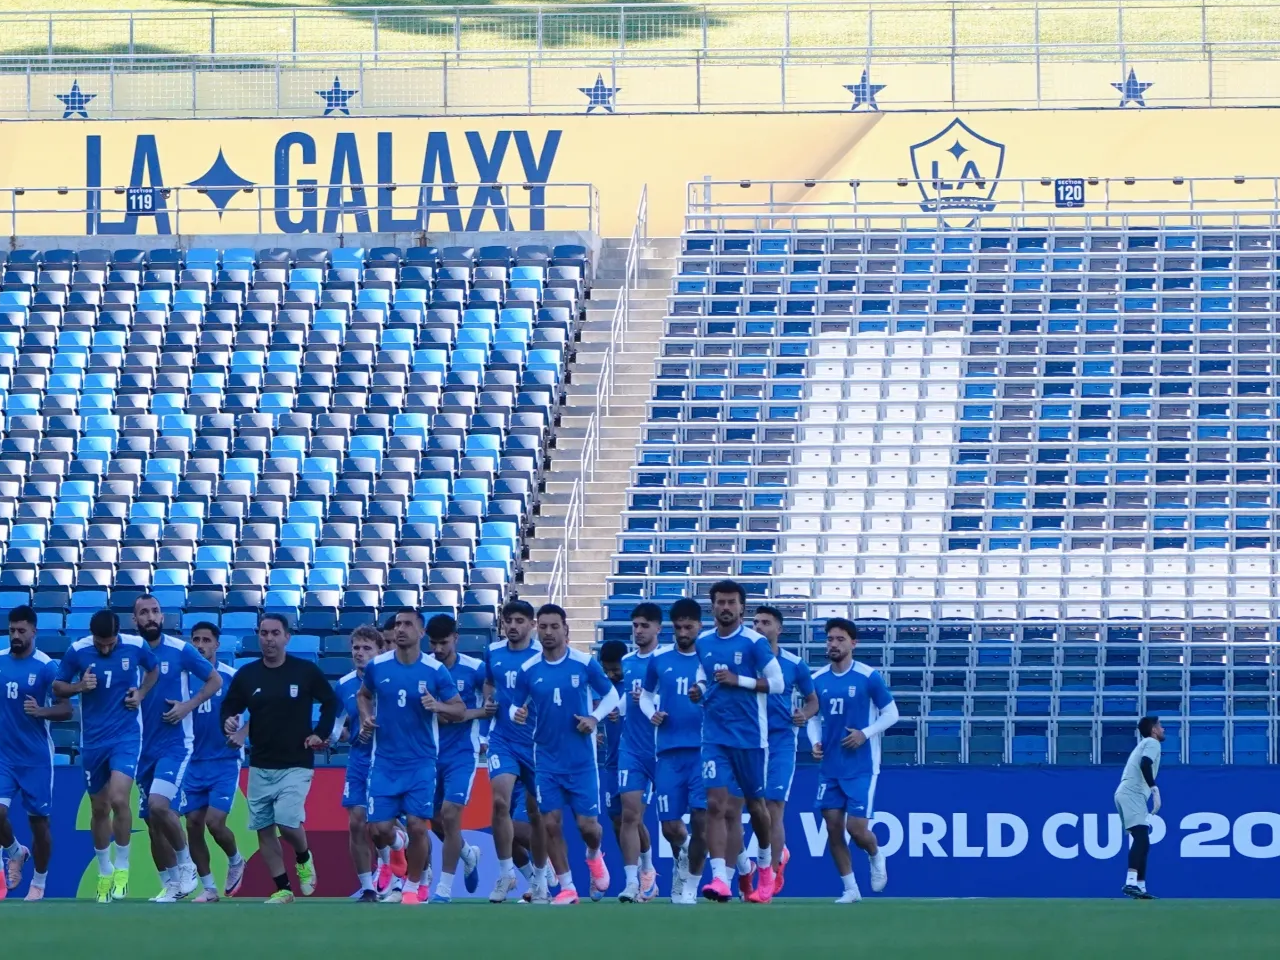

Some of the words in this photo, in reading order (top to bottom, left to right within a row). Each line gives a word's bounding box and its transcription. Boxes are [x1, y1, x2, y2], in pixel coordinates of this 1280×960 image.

[86, 134, 171, 235] LA
[274, 130, 562, 234] GALAXY
[932, 160, 986, 190] LA
[130, 194, 153, 210] 119
[1058, 185, 1082, 201] 120
[104, 670, 113, 689] 7
[505, 670, 518, 689] 16
[675, 676, 689, 696] 11
[6, 681, 19, 700] 13
[397, 689, 407, 708] 3
[553, 687, 563, 707] 4
[829, 697, 844, 716] 27
[658, 794, 670, 813] 11
[1179, 811, 1280, 859] 20
